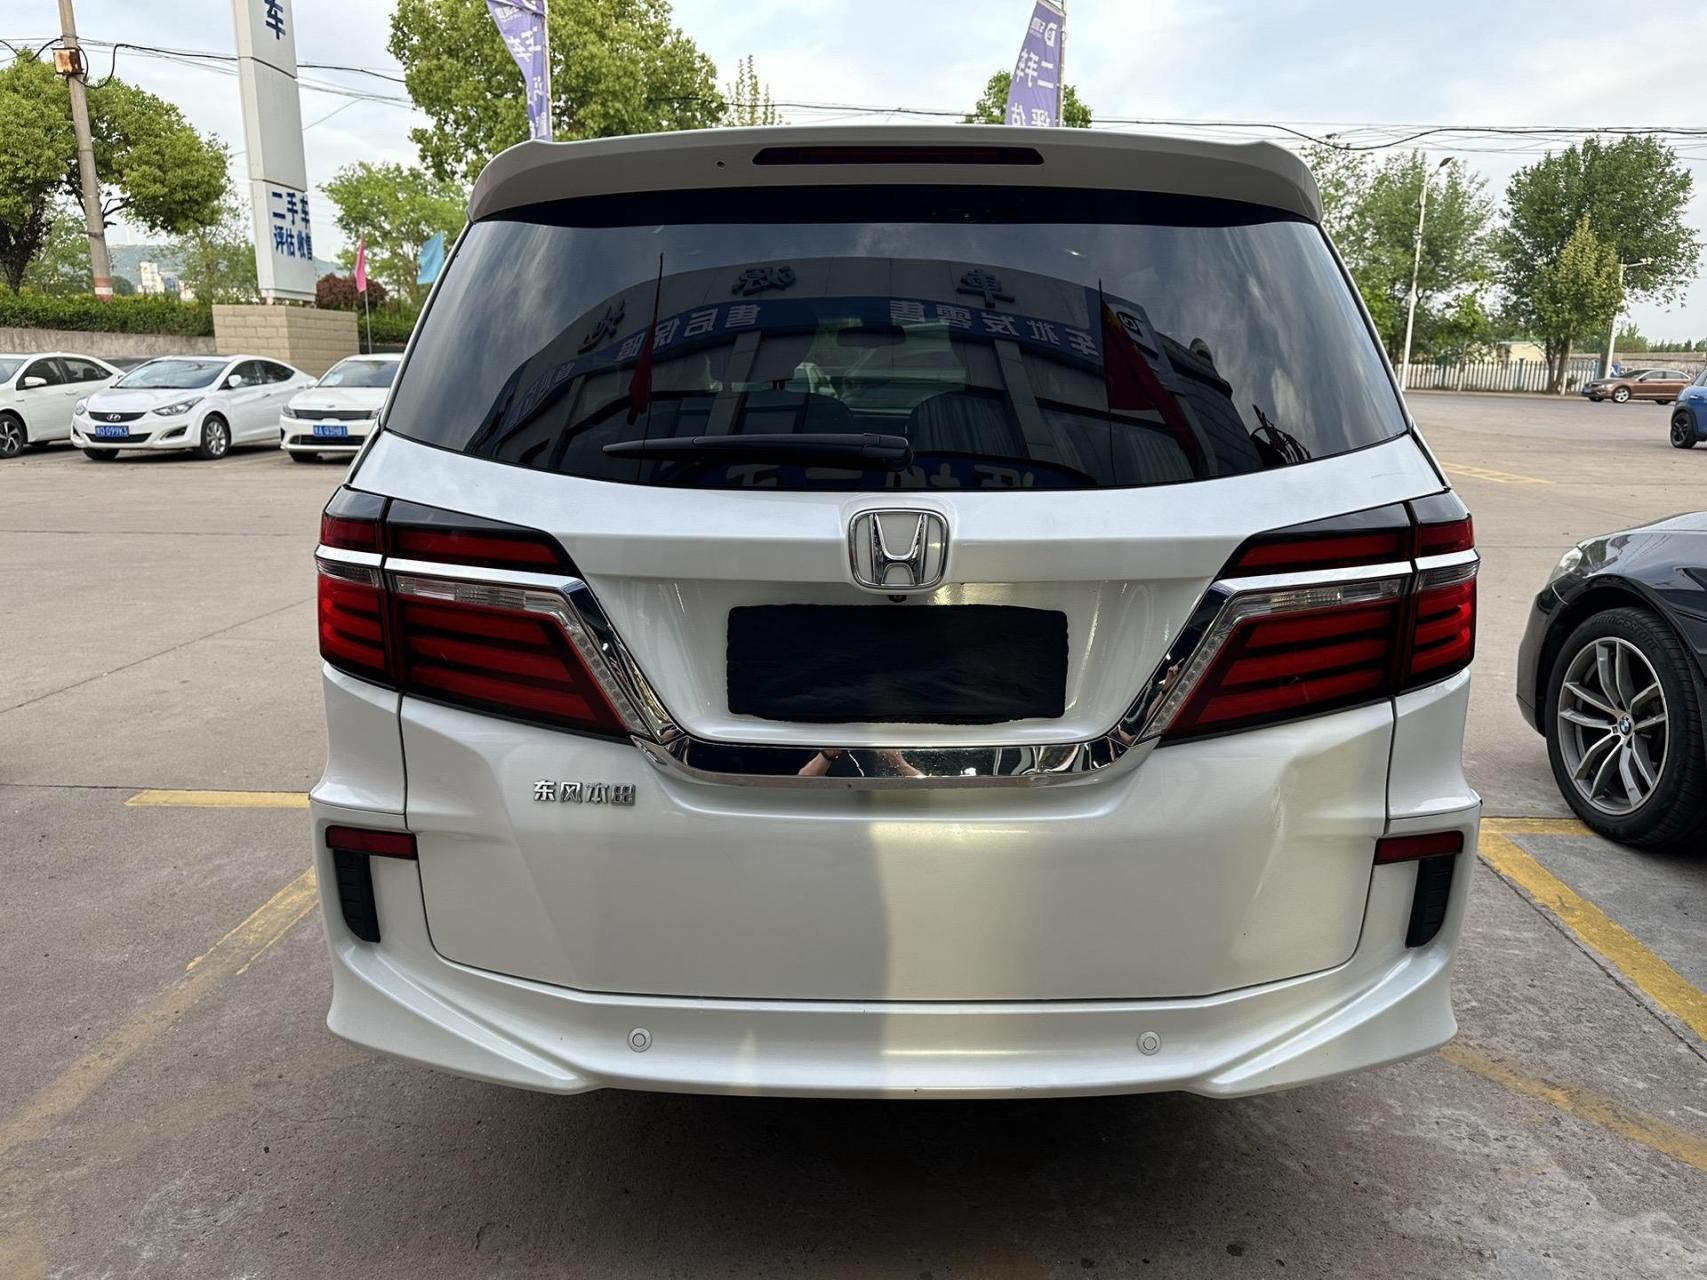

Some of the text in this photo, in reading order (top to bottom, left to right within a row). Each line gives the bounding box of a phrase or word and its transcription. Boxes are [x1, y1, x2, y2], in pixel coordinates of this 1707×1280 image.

[272, 191, 310, 229] 二手车
[533, 780, 636, 806] 东风本田
